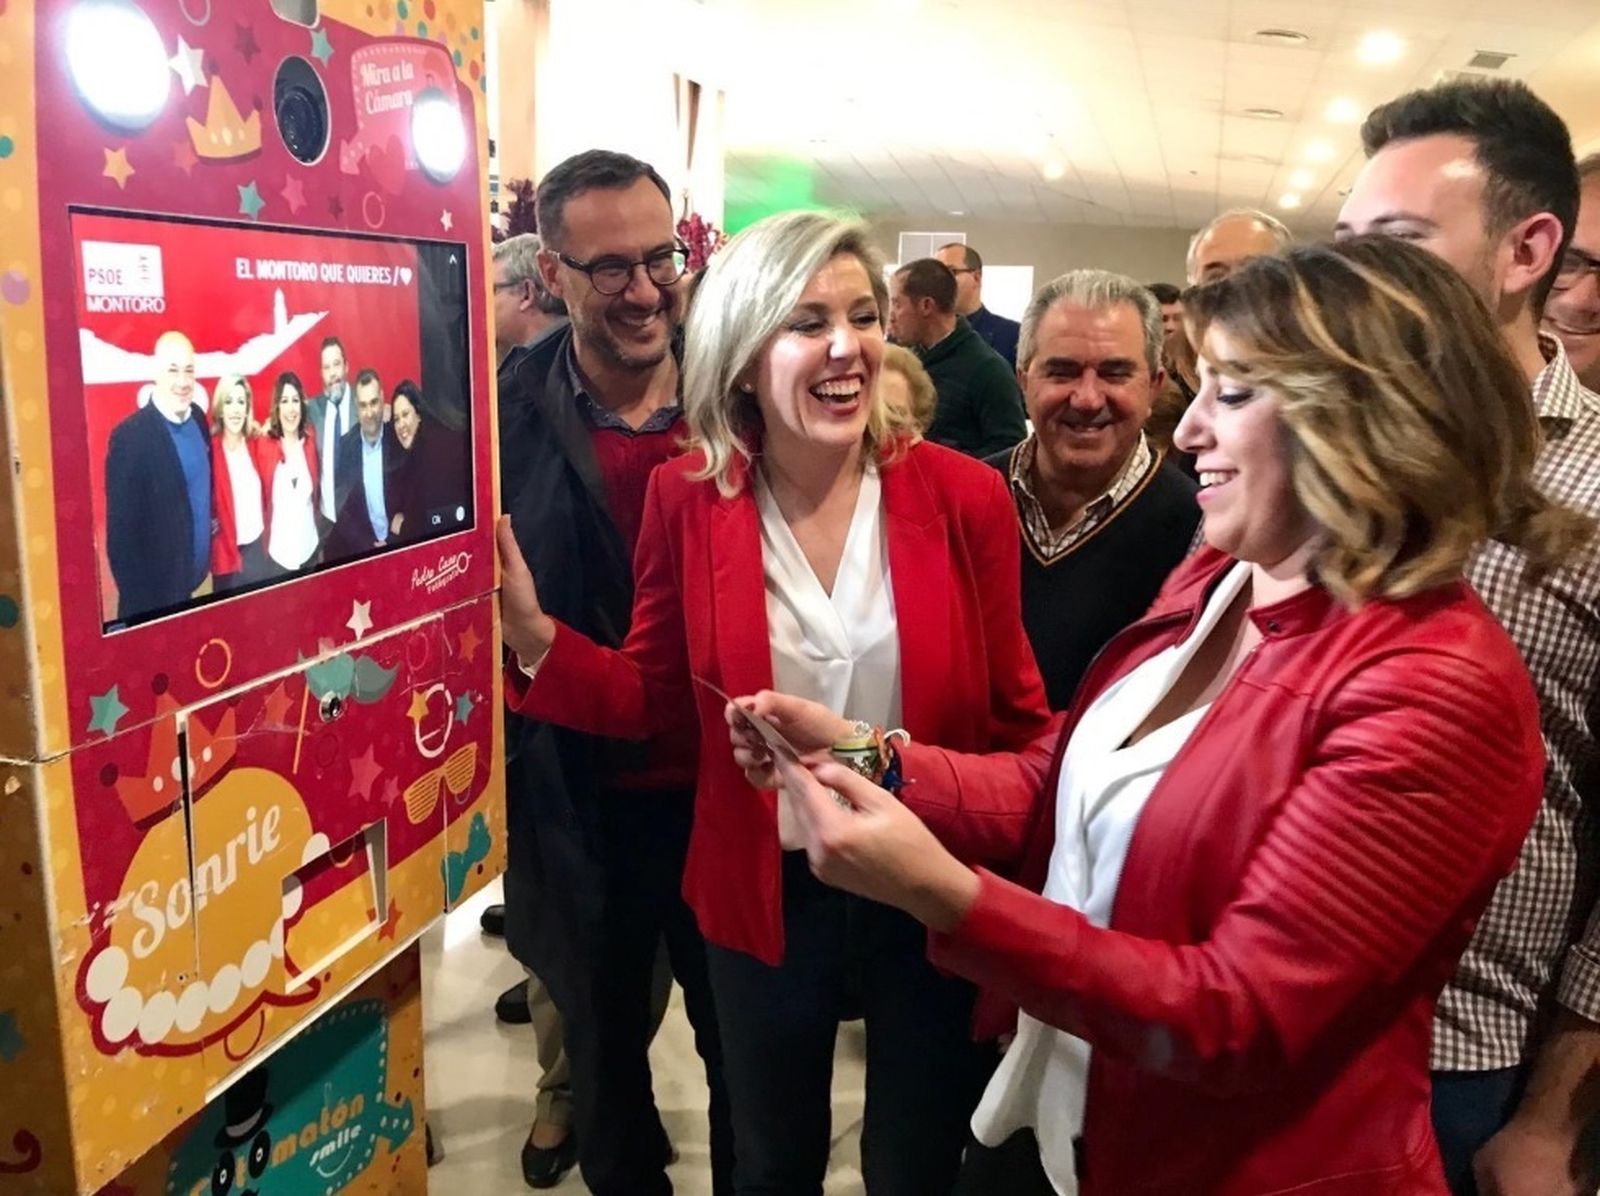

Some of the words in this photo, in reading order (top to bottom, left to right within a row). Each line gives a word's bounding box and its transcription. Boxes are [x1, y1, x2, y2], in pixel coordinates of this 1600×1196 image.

[360, 63, 391, 88] Mira
[392, 65, 401, 81] a
[401, 60, 414, 80] la
[87, 267, 123, 286] PSOE
[236, 256, 254, 280] EL
[256, 258, 318, 282] MONTORO
[320, 262, 344, 283] QUE
[346, 264, 391, 284] QUIERES
[86, 294, 166, 314] MONTORO
[132, 804, 281, 959] Sonrie
[309, 1124, 362, 1168] smile
